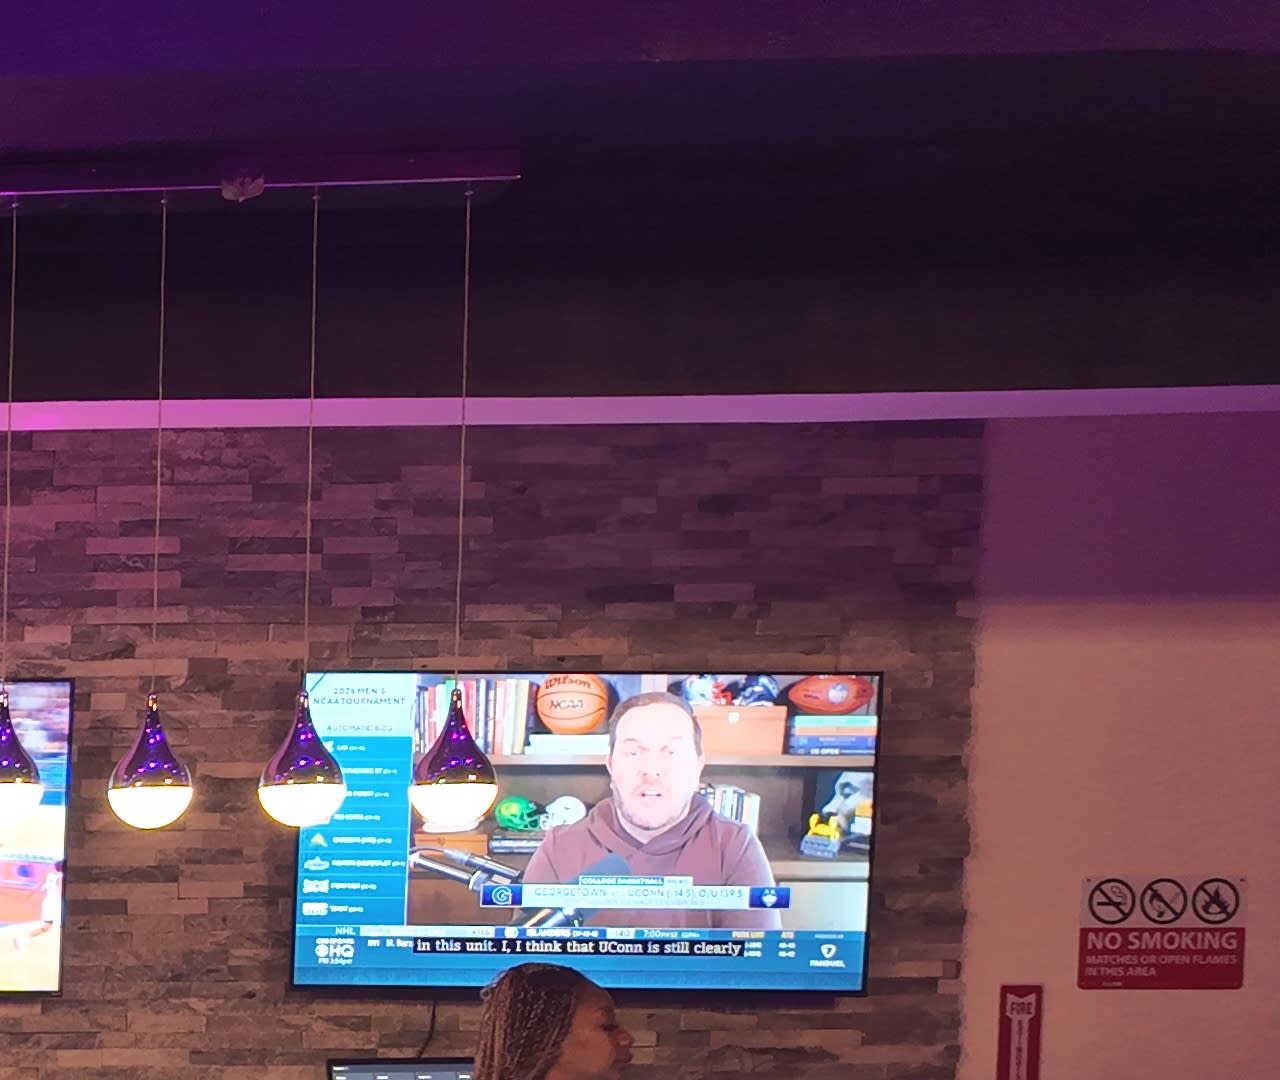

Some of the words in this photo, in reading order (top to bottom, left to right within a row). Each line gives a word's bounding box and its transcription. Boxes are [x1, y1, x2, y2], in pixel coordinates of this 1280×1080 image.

[341, 697, 406, 705] TOURNAMENT
[534, 888, 607, 897] GEORGETOWN
[628, 888, 664, 897] UCONN
[335, 927, 356, 935] NHL
[1087, 932, 1122, 950] NO
[1127, 931, 1238, 950] SMOKING
[329, 945, 355, 958] HQ
[417, 940, 430, 951] in
[435, 939, 462, 951] this
[465, 940, 497, 952] unit.
[501, 940, 511, 954] I,
[515, 940, 522, 952] I
[525, 940, 562, 952] think
[566, 941, 594, 953] that
[598, 941, 643, 953] UConn
[647, 941, 660, 953] is
[664, 941, 690, 953] still
[694, 942, 742, 957] clearly
[1086, 955, 1139, 965] MATCHES
[1140, 955, 1157, 964] OR
[1159, 955, 1190, 965] OPEN
[1192, 955, 1238, 965] FLAMES
[1085, 967, 1098, 977] IN
[1099, 967, 1125, 977] THIS
[1126, 967, 1157, 977] AREA
[1010, 1002, 1033, 1016] FIRE
